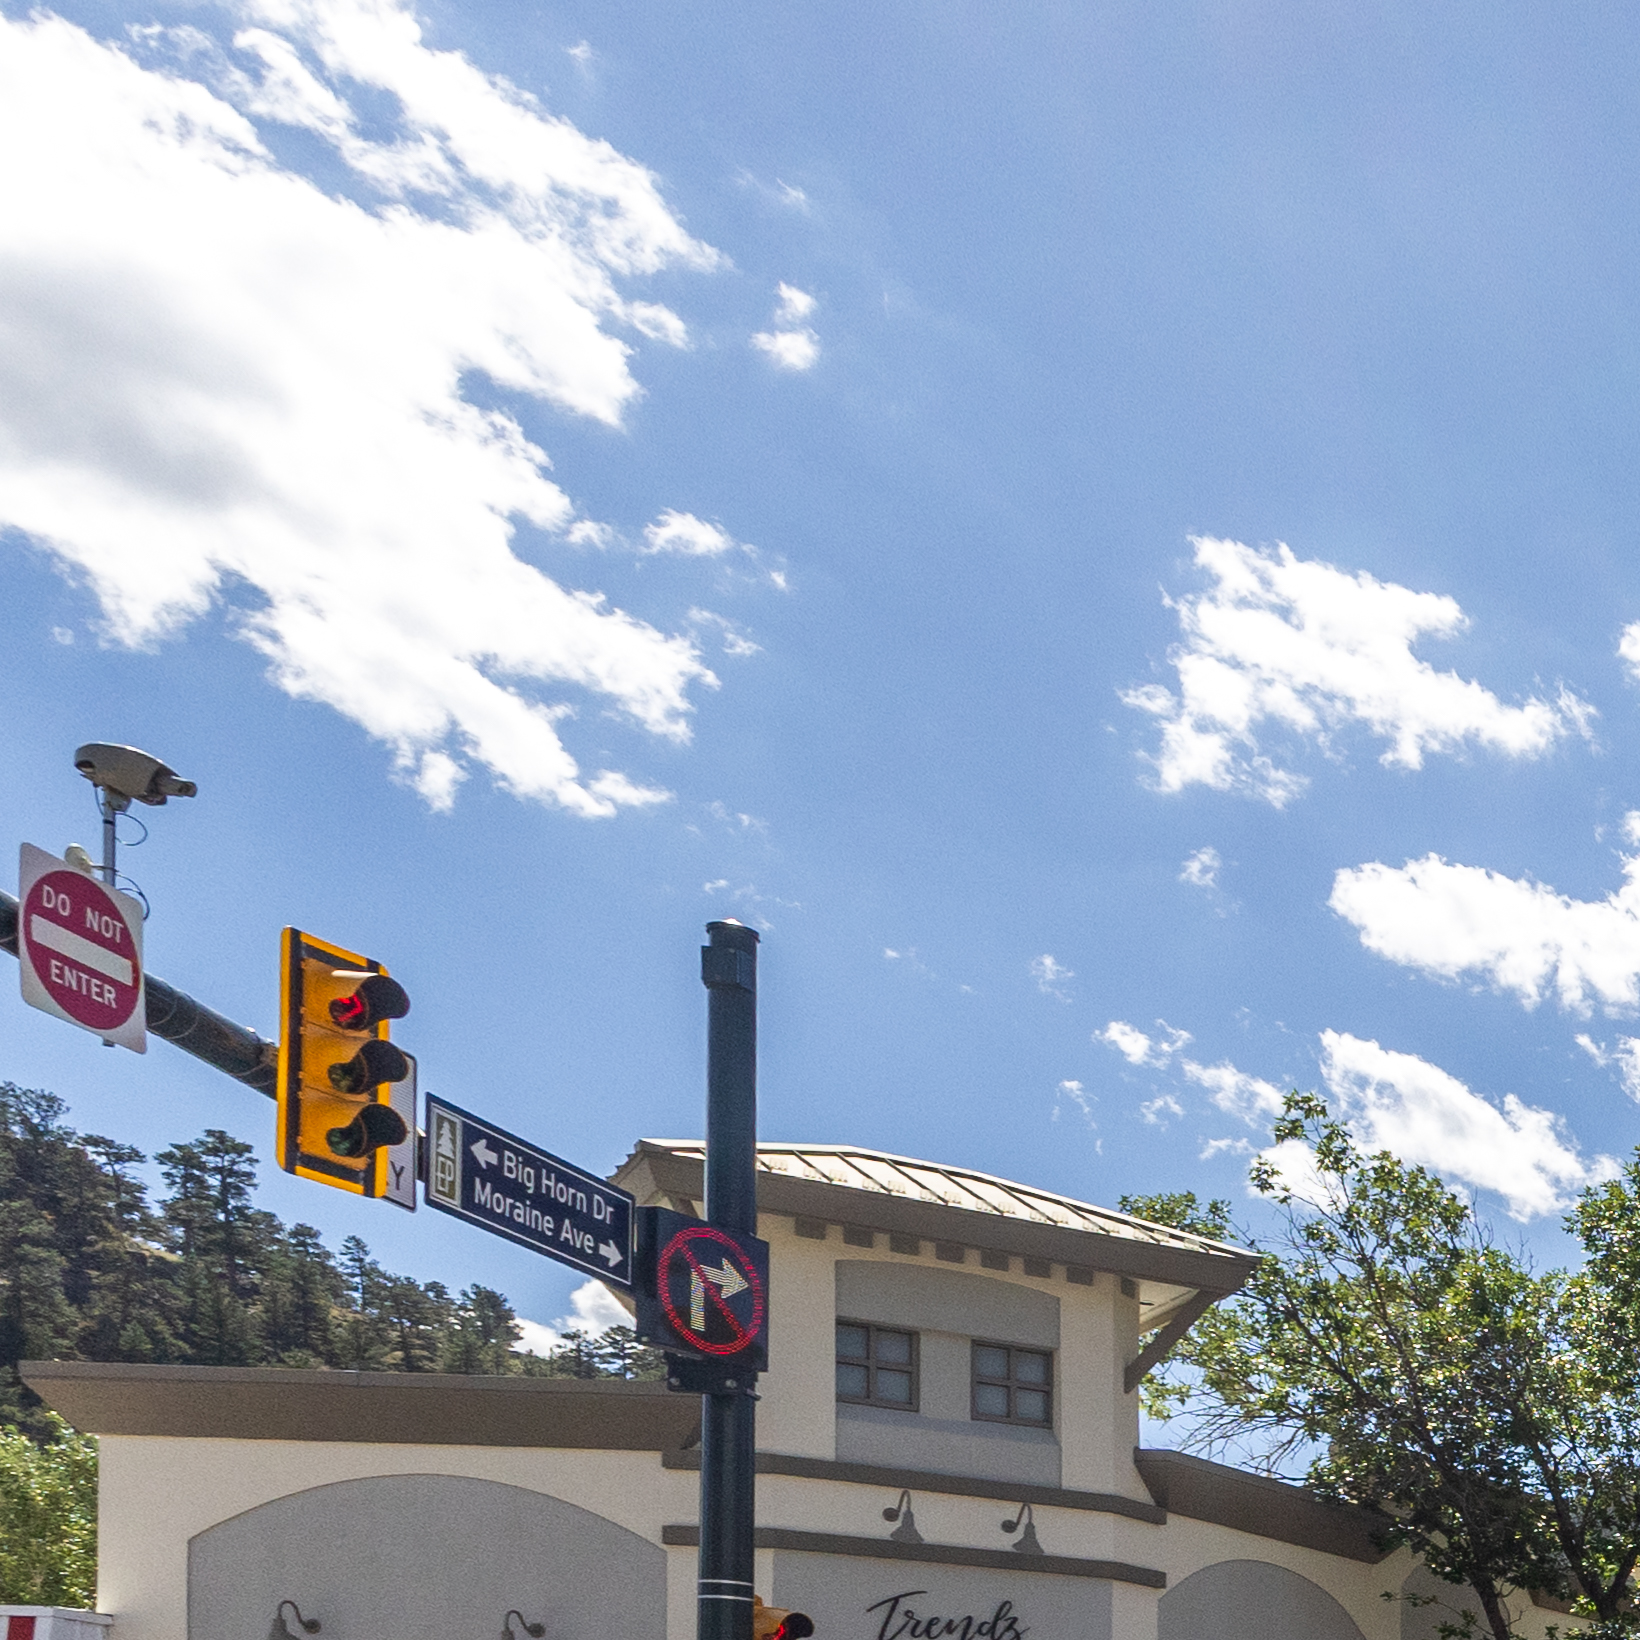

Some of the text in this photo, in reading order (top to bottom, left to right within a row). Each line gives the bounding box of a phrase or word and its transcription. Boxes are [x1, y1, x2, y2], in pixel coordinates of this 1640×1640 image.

[42, 884, 124, 943] DO NOT
[50, 959, 117, 1008] ENTER
[474, 1178, 594, 1254] Moraine Ave
[503, 1150, 614, 1225] Big Horn Dr
